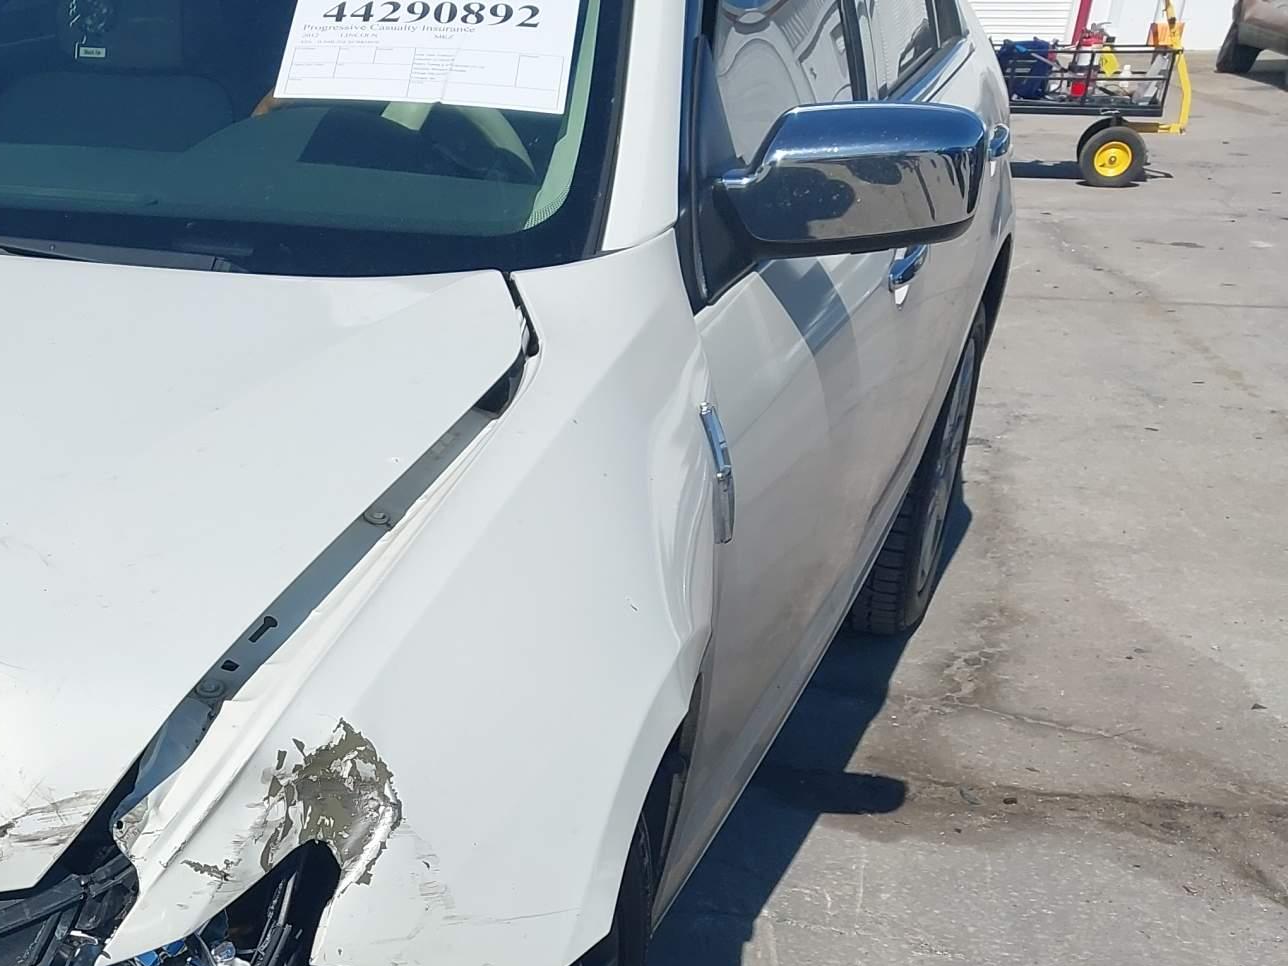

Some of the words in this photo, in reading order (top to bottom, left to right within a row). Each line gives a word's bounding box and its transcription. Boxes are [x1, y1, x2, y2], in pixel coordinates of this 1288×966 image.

[323, 0, 540, 28] 44290892
[303, 24, 367, 33] Progressive
[369, 24, 418, 33] Casualty
[422, 24, 476, 33] Insurance
